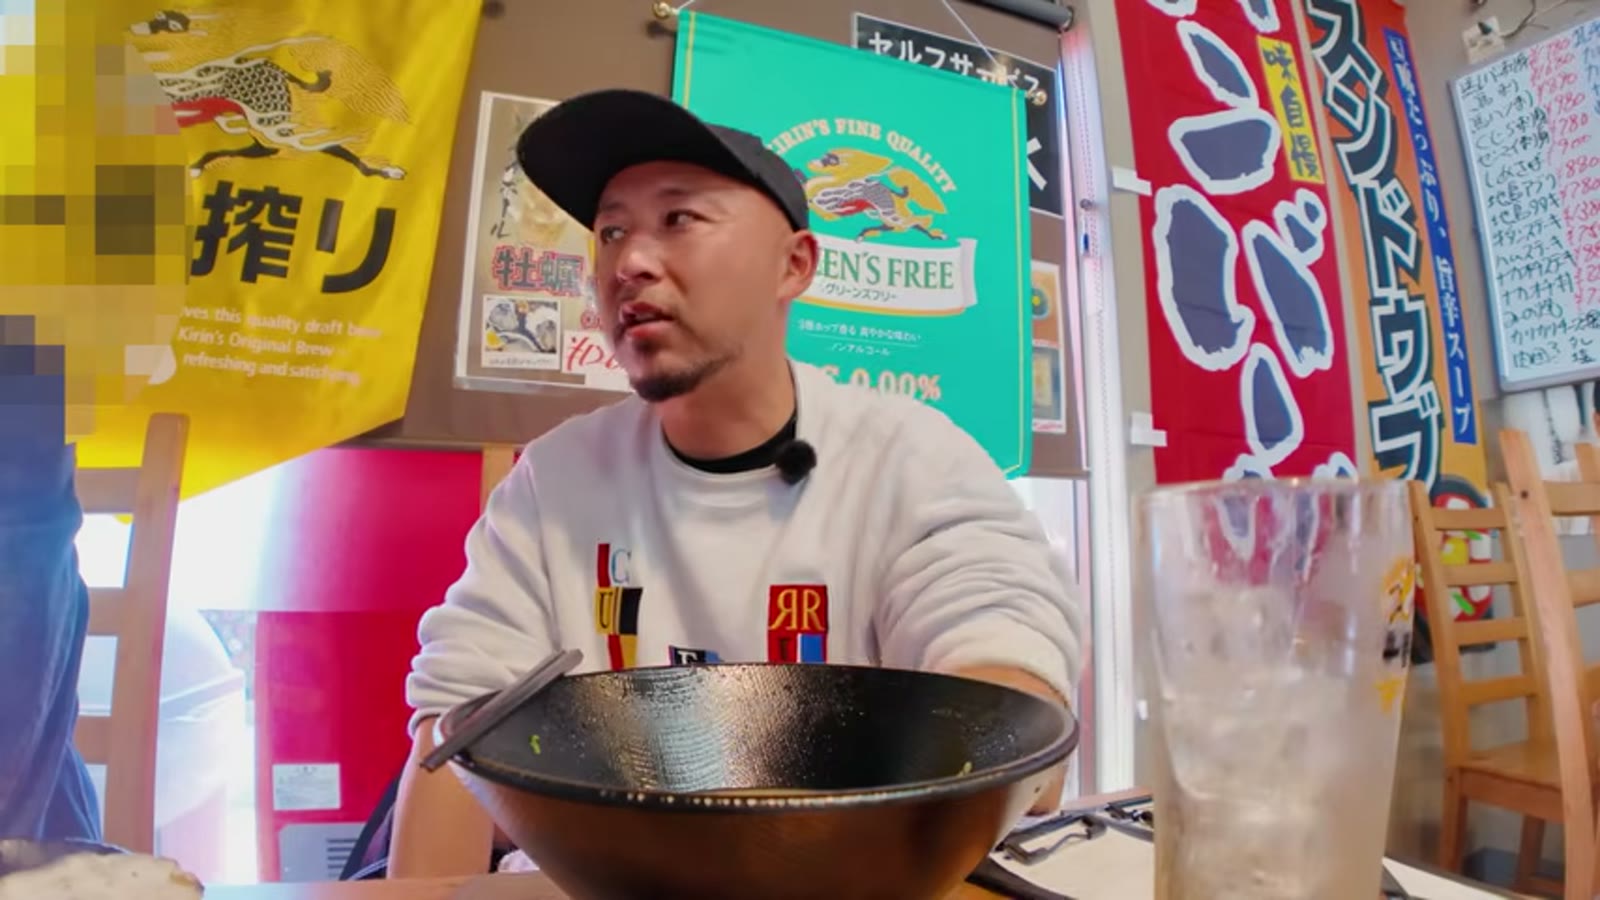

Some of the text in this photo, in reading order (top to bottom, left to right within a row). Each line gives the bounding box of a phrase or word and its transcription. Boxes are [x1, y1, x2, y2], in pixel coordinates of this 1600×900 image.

[1262, 42, 1320, 178] 味自慢
[766, 117, 957, 193] IRIN'S FINE QUALITY
[815, 247, 955, 290] EN'S FREE
[214, 306, 241, 323] this
[246, 313, 300, 334] quality
[304, 315, 343, 335] draft
[178, 327, 225, 346] Kirin's
[228, 331, 292, 354] Original
[183, 350, 257, 378] refreshing
[258, 361, 288, 378] and
